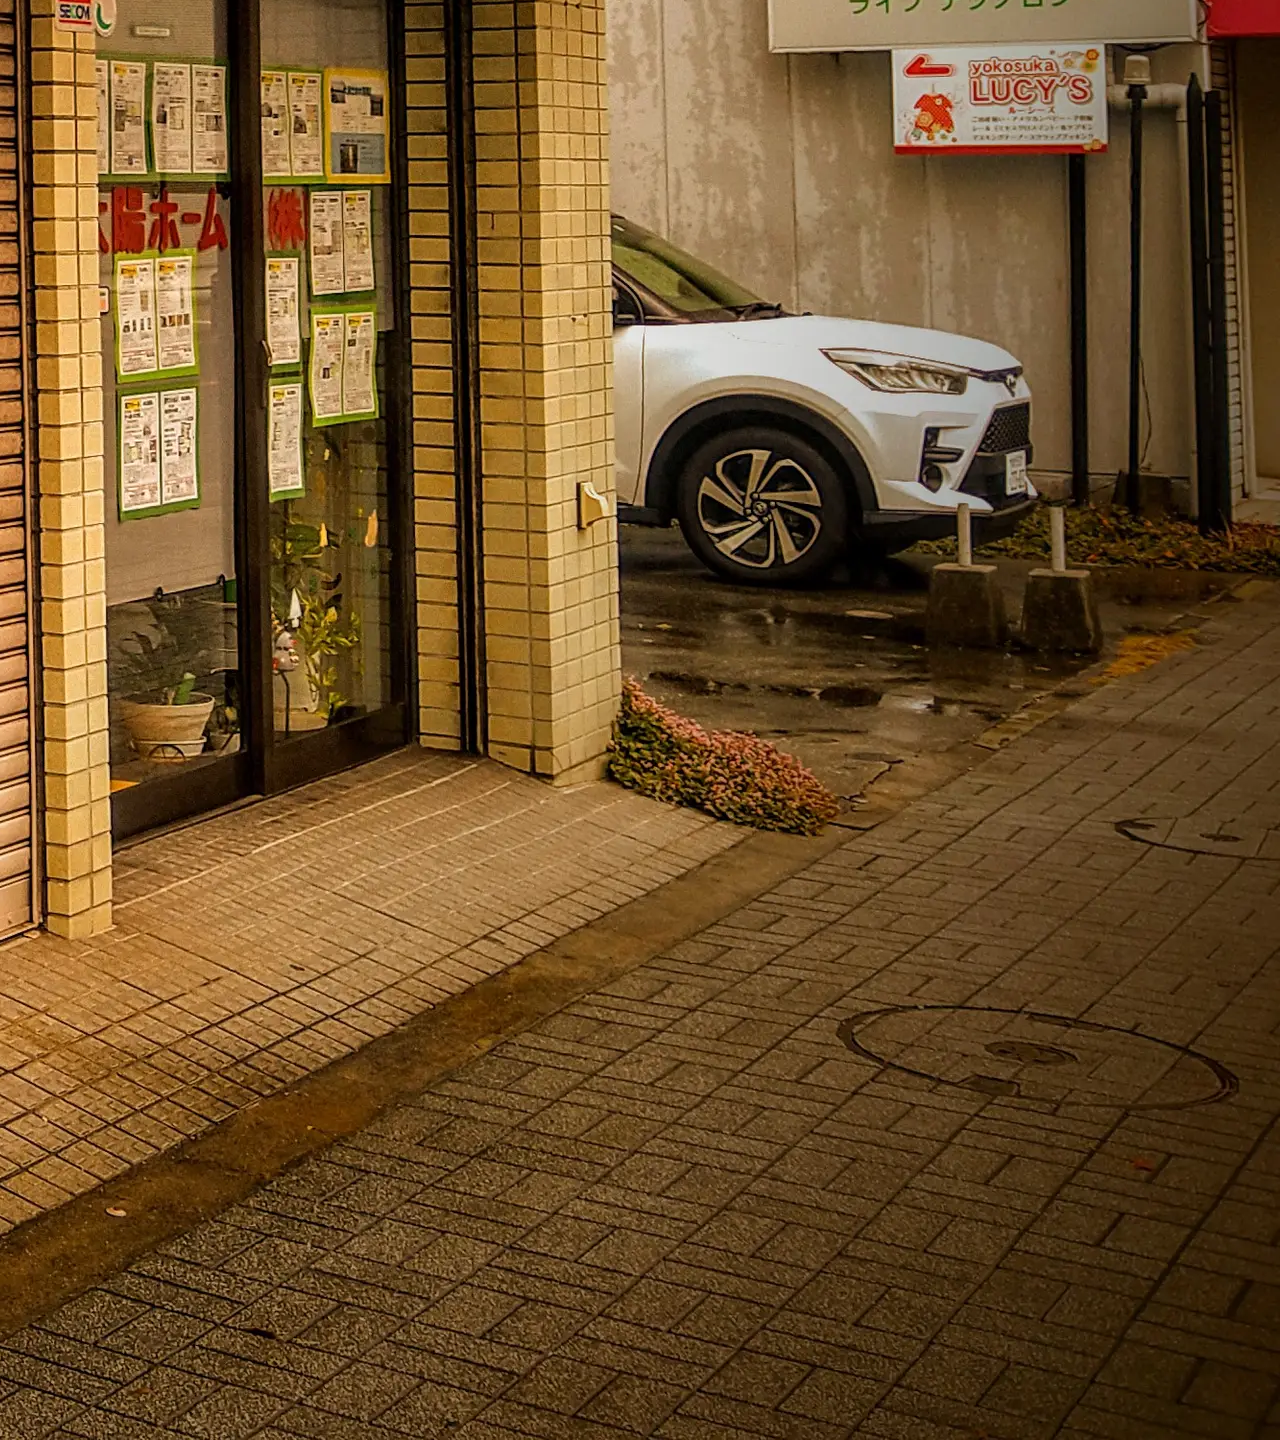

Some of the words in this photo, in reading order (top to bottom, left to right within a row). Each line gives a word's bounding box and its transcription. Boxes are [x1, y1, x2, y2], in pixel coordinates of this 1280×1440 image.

[60, 4, 90, 20] SECOM
[970, 58, 1056, 75] yokosuka
[971, 75, 1091, 104] LUCY'S
